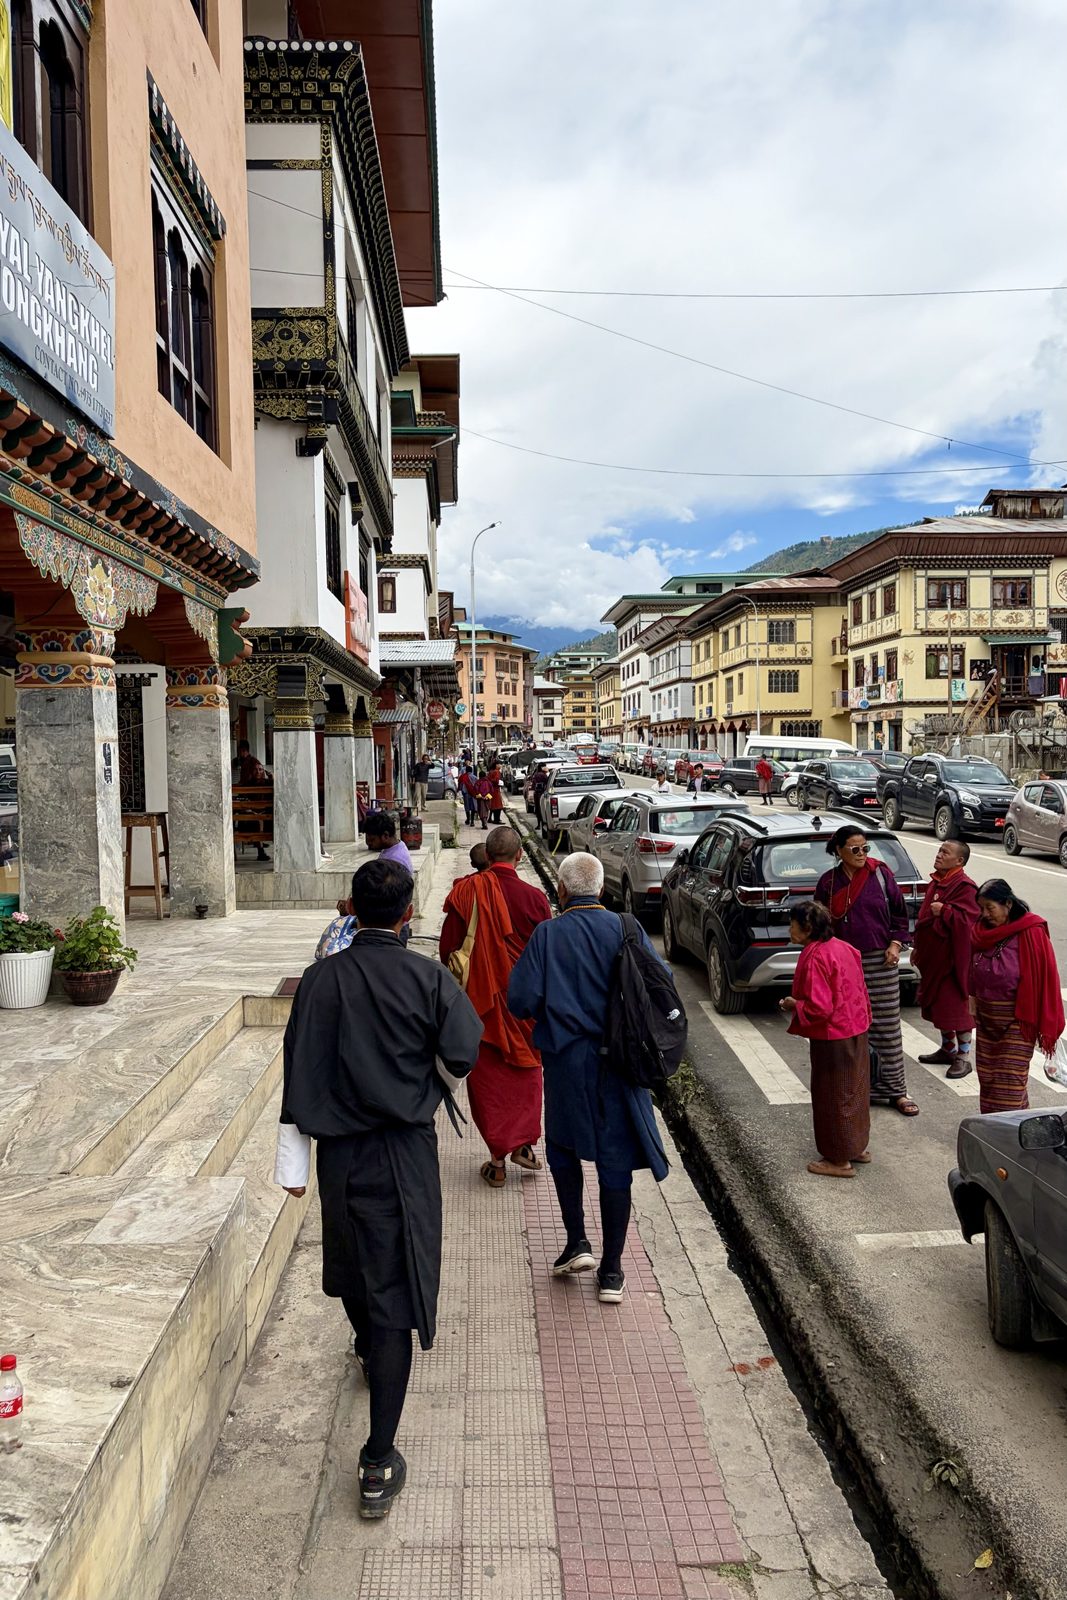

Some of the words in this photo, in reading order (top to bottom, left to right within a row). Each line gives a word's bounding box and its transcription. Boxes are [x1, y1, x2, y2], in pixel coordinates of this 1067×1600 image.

[1, 265, 98, 392] ONGKHANG
[34, 344, 67, 386] CONTACT
[35, 251, 113, 371] YANGKHEL
